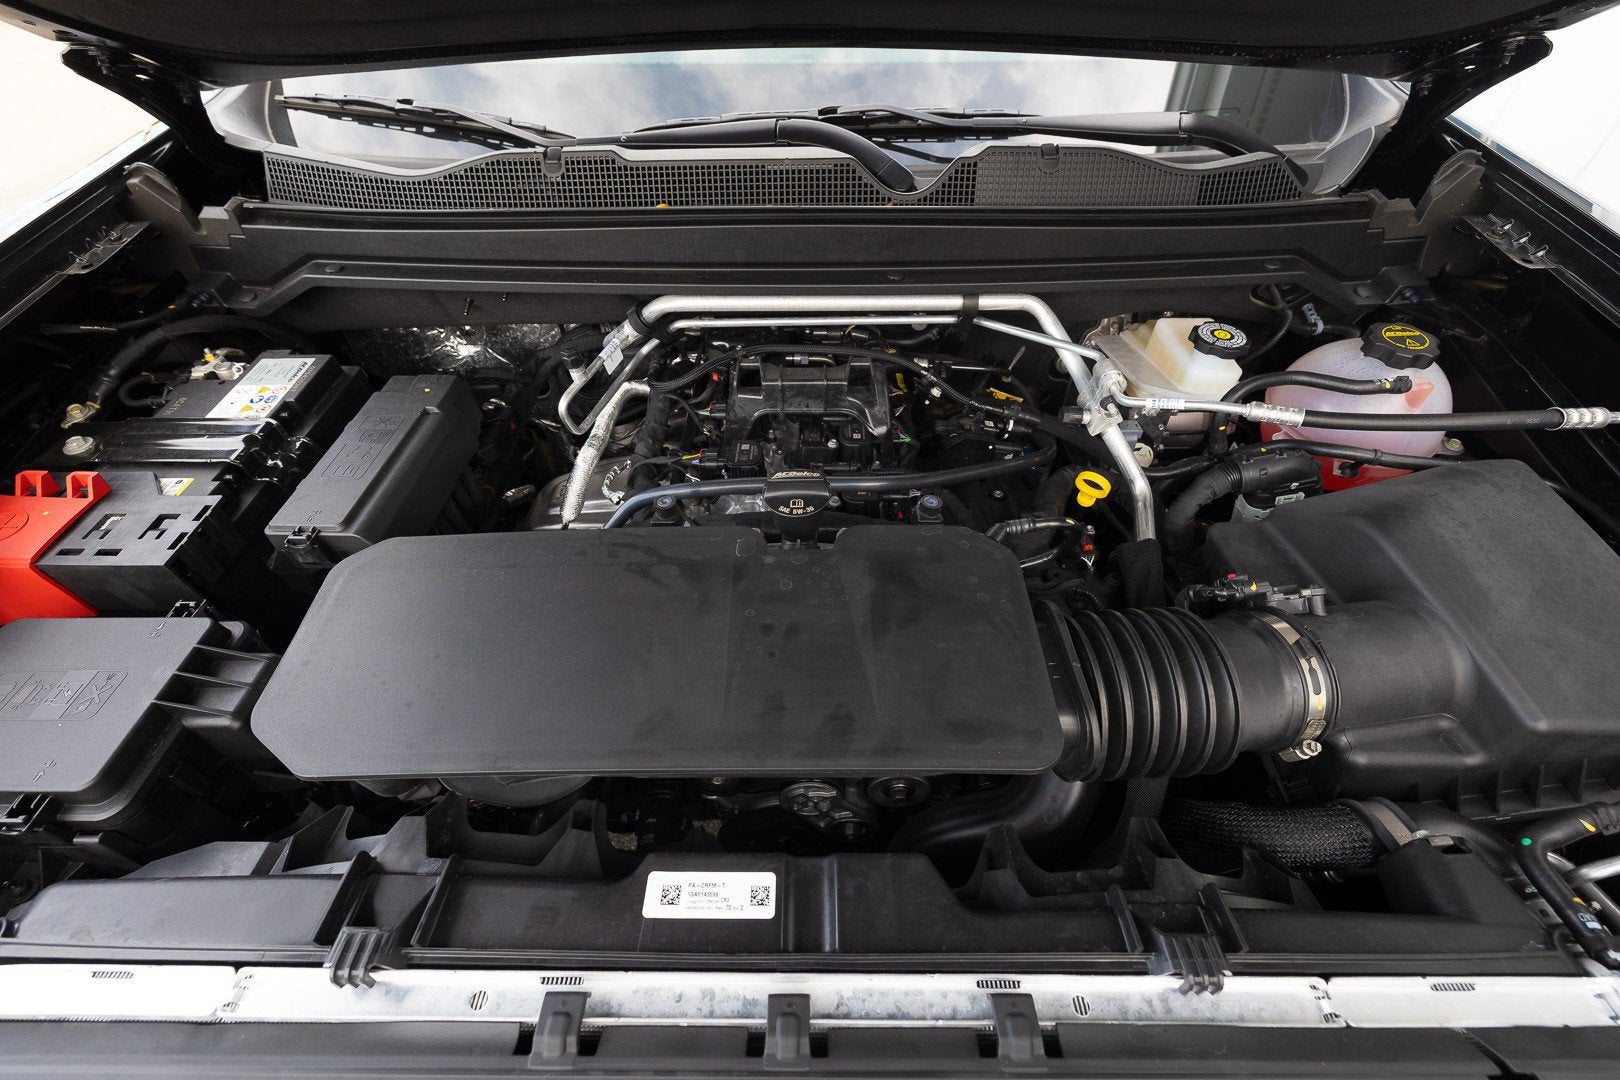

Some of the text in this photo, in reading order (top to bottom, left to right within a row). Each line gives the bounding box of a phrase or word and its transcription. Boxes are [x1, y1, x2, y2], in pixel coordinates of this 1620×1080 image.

[771, 471, 820, 479] ACDelco
[778, 505, 815, 515] SAE 5W-30
